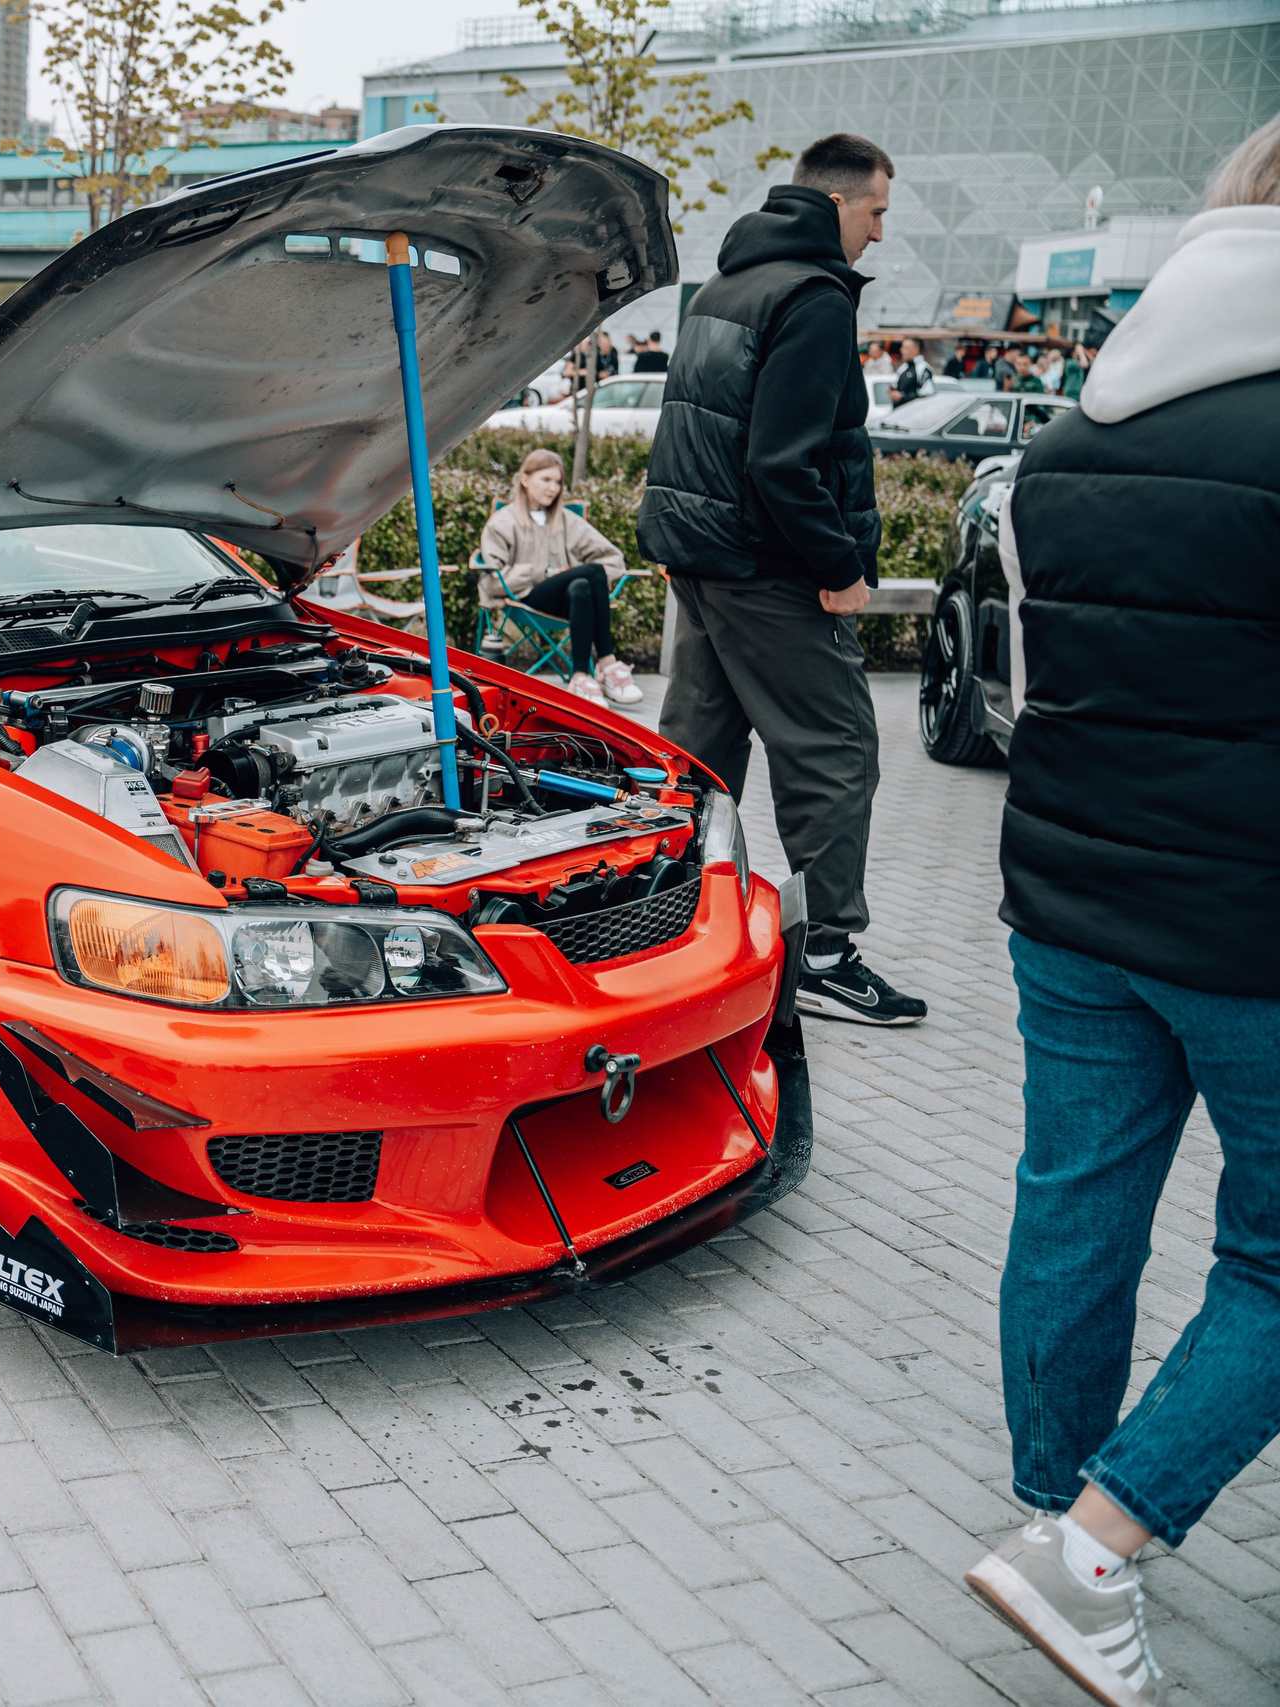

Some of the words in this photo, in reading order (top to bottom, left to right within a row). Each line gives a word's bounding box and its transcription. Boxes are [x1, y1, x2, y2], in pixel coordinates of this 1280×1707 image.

[125, 781, 145, 790] HKS
[9, 1285, 38, 1306] SUZUKA
[39, 1300, 62, 1317] JAPAN
